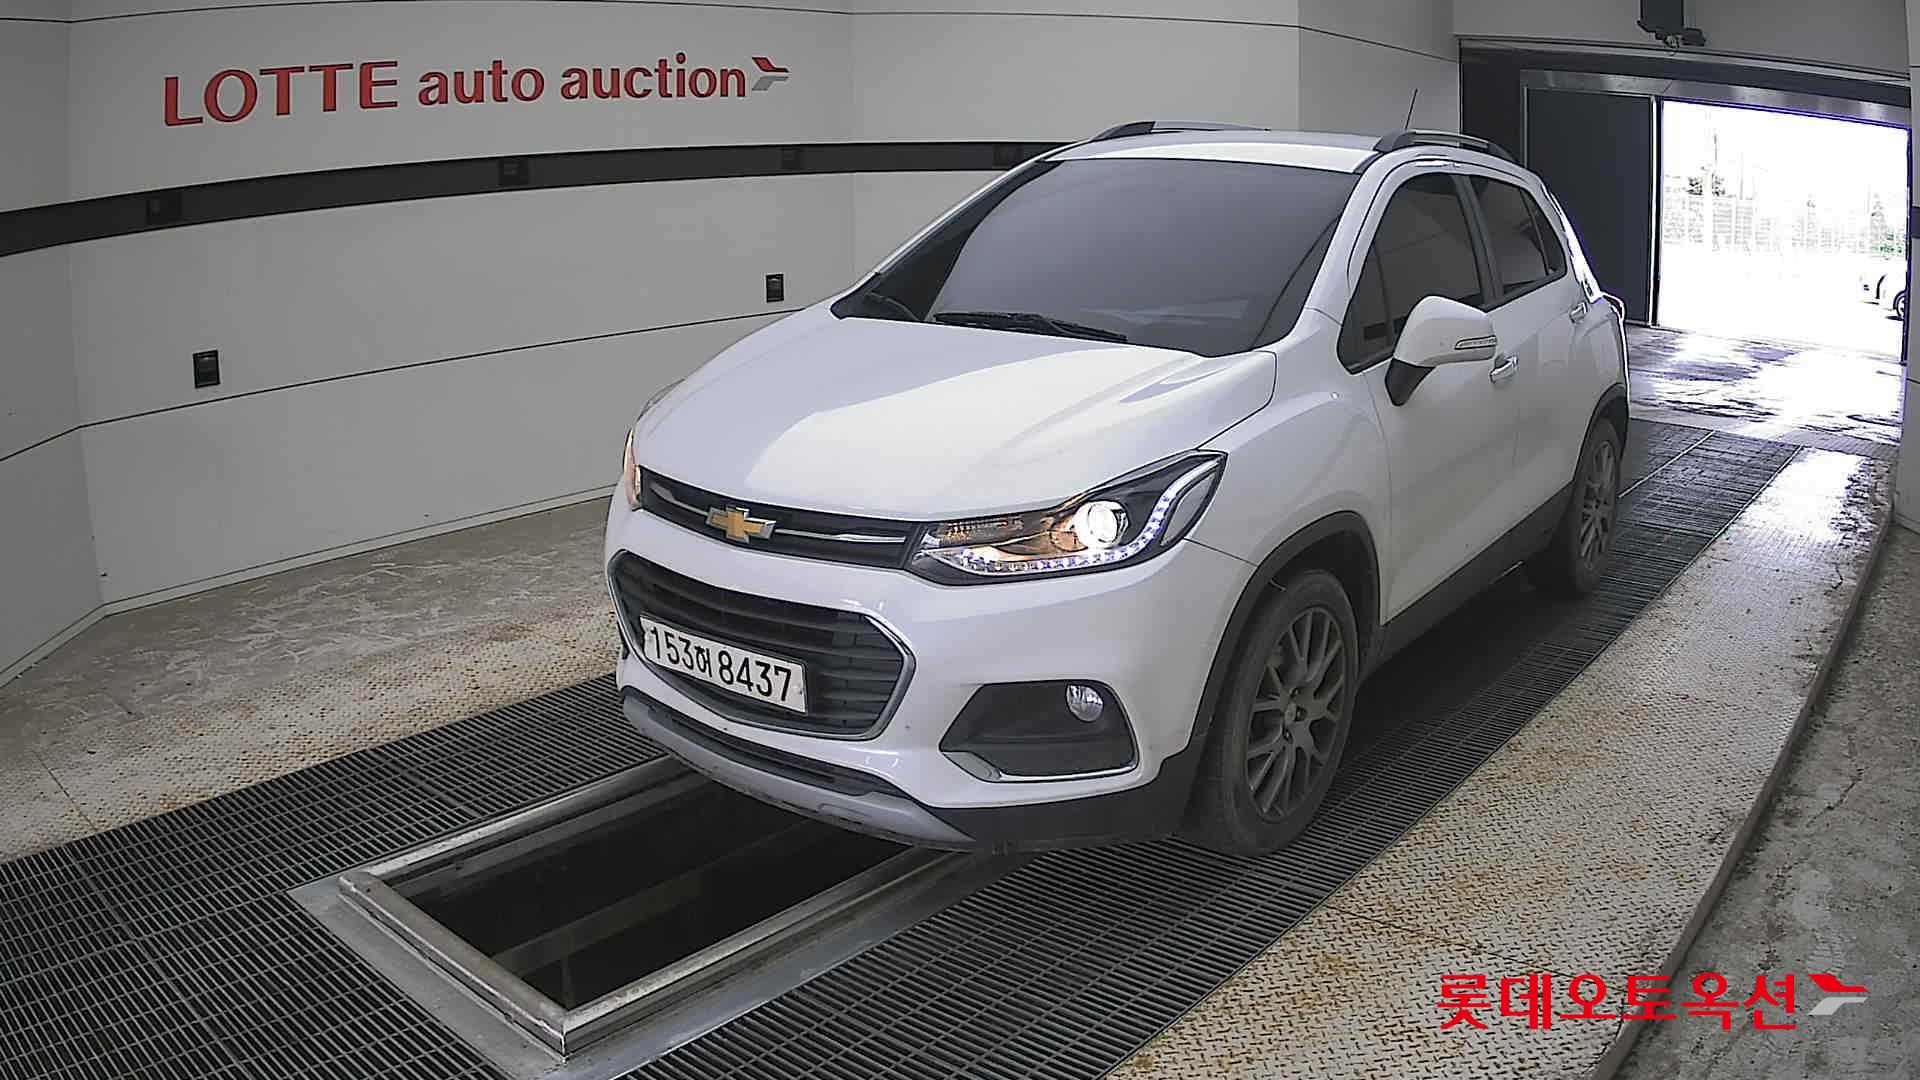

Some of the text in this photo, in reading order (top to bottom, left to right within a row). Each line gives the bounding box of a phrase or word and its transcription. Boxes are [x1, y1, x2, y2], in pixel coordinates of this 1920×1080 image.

[163, 51, 748, 127] LOTTE auto auction
